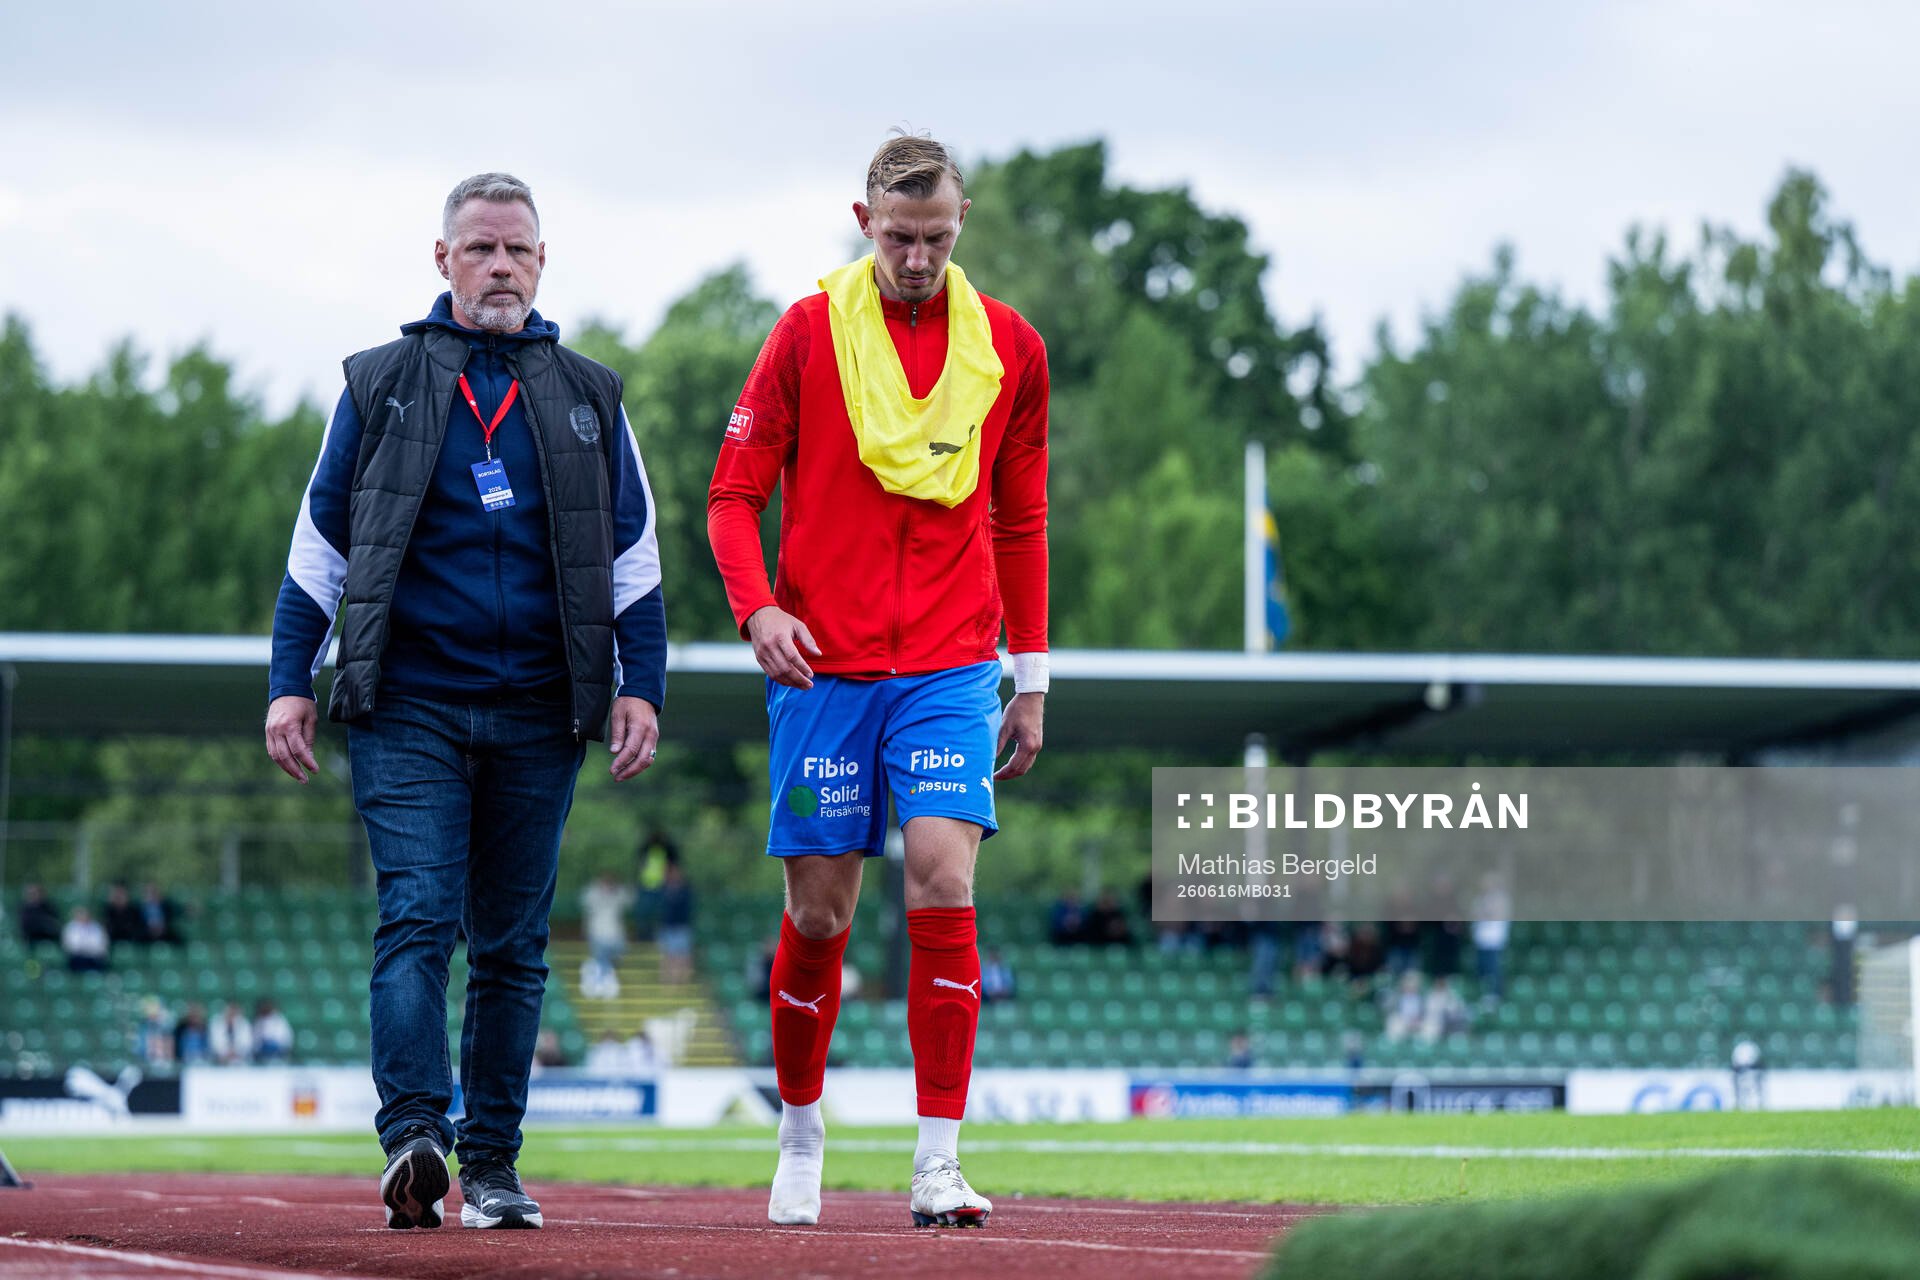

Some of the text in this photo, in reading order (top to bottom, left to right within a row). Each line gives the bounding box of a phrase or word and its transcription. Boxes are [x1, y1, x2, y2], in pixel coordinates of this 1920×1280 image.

[803, 756, 859, 779] Fibio
[910, 747, 965, 772] Fibio
[820, 784, 860, 805] Solid
[918, 781, 967, 794] Resurs
[820, 803, 870, 818] Försäkring
